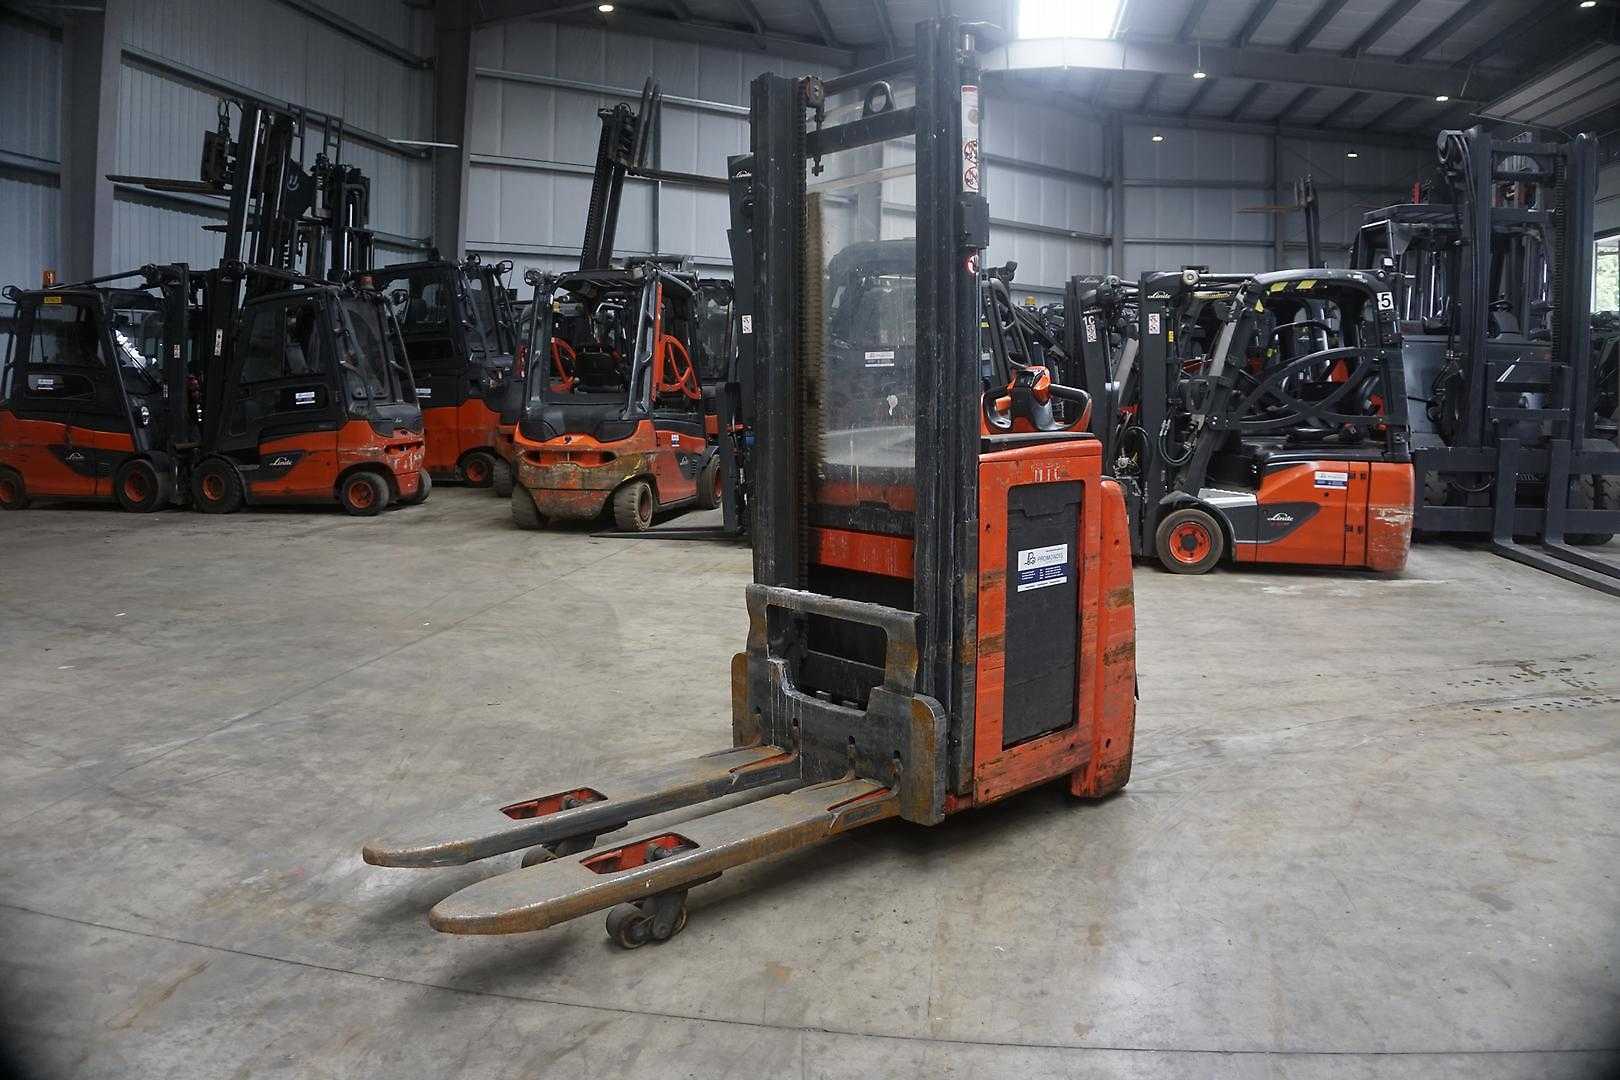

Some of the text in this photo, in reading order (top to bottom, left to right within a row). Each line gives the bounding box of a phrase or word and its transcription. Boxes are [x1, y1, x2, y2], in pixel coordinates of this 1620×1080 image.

[1147, 291, 1171, 299] Linde
[1381, 293, 1391, 308] 5
[1267, 512, 1294, 521] Linde
